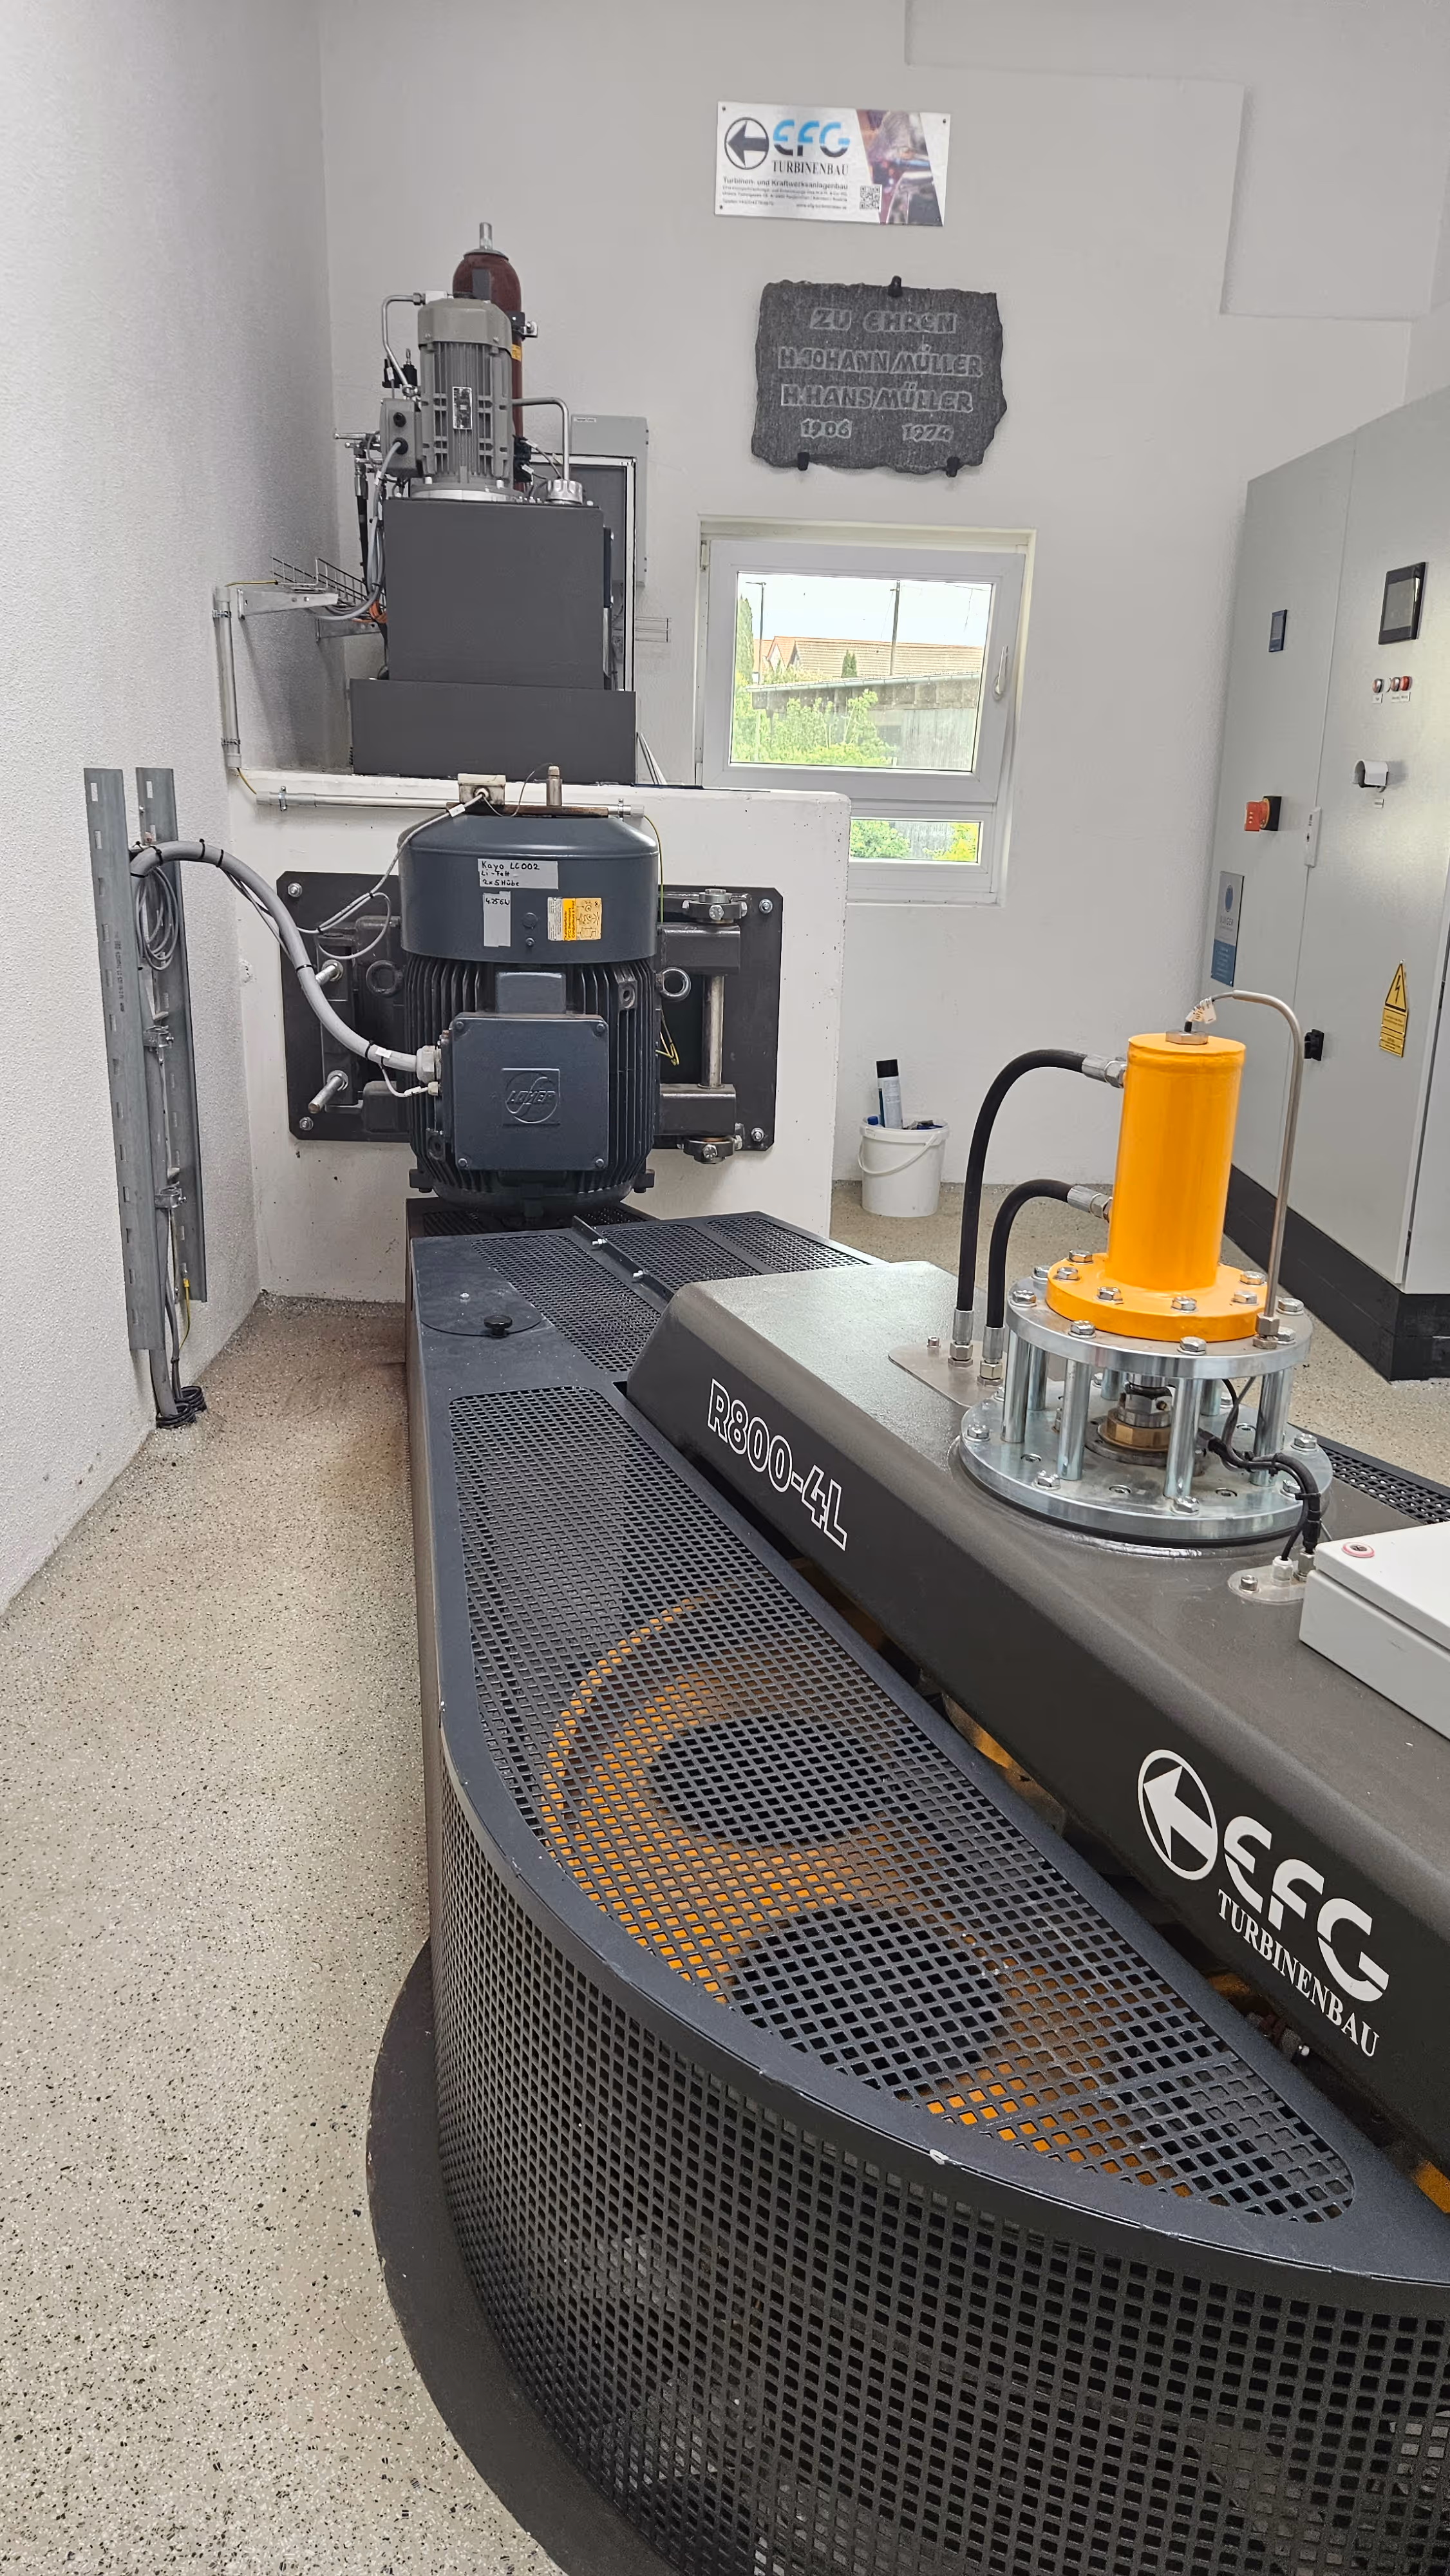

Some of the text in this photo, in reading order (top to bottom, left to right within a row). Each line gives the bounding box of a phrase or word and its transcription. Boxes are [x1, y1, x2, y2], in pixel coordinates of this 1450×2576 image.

[772, 118, 851, 158] EFG
[723, 176, 755, 185] Turbinen-
[771, 180, 848, 190] Kraftwerksanlagenbau
[771, 160, 849, 176] TURBINENBAU
[810, 307, 957, 334] ZU EHREN
[800, 418, 954, 442] 1906 1974
[707, 1378, 848, 1551] R800-4L
[1223, 1815, 1389, 2002] EFG
[1217, 1888, 1380, 2058] TURBINENBAU
